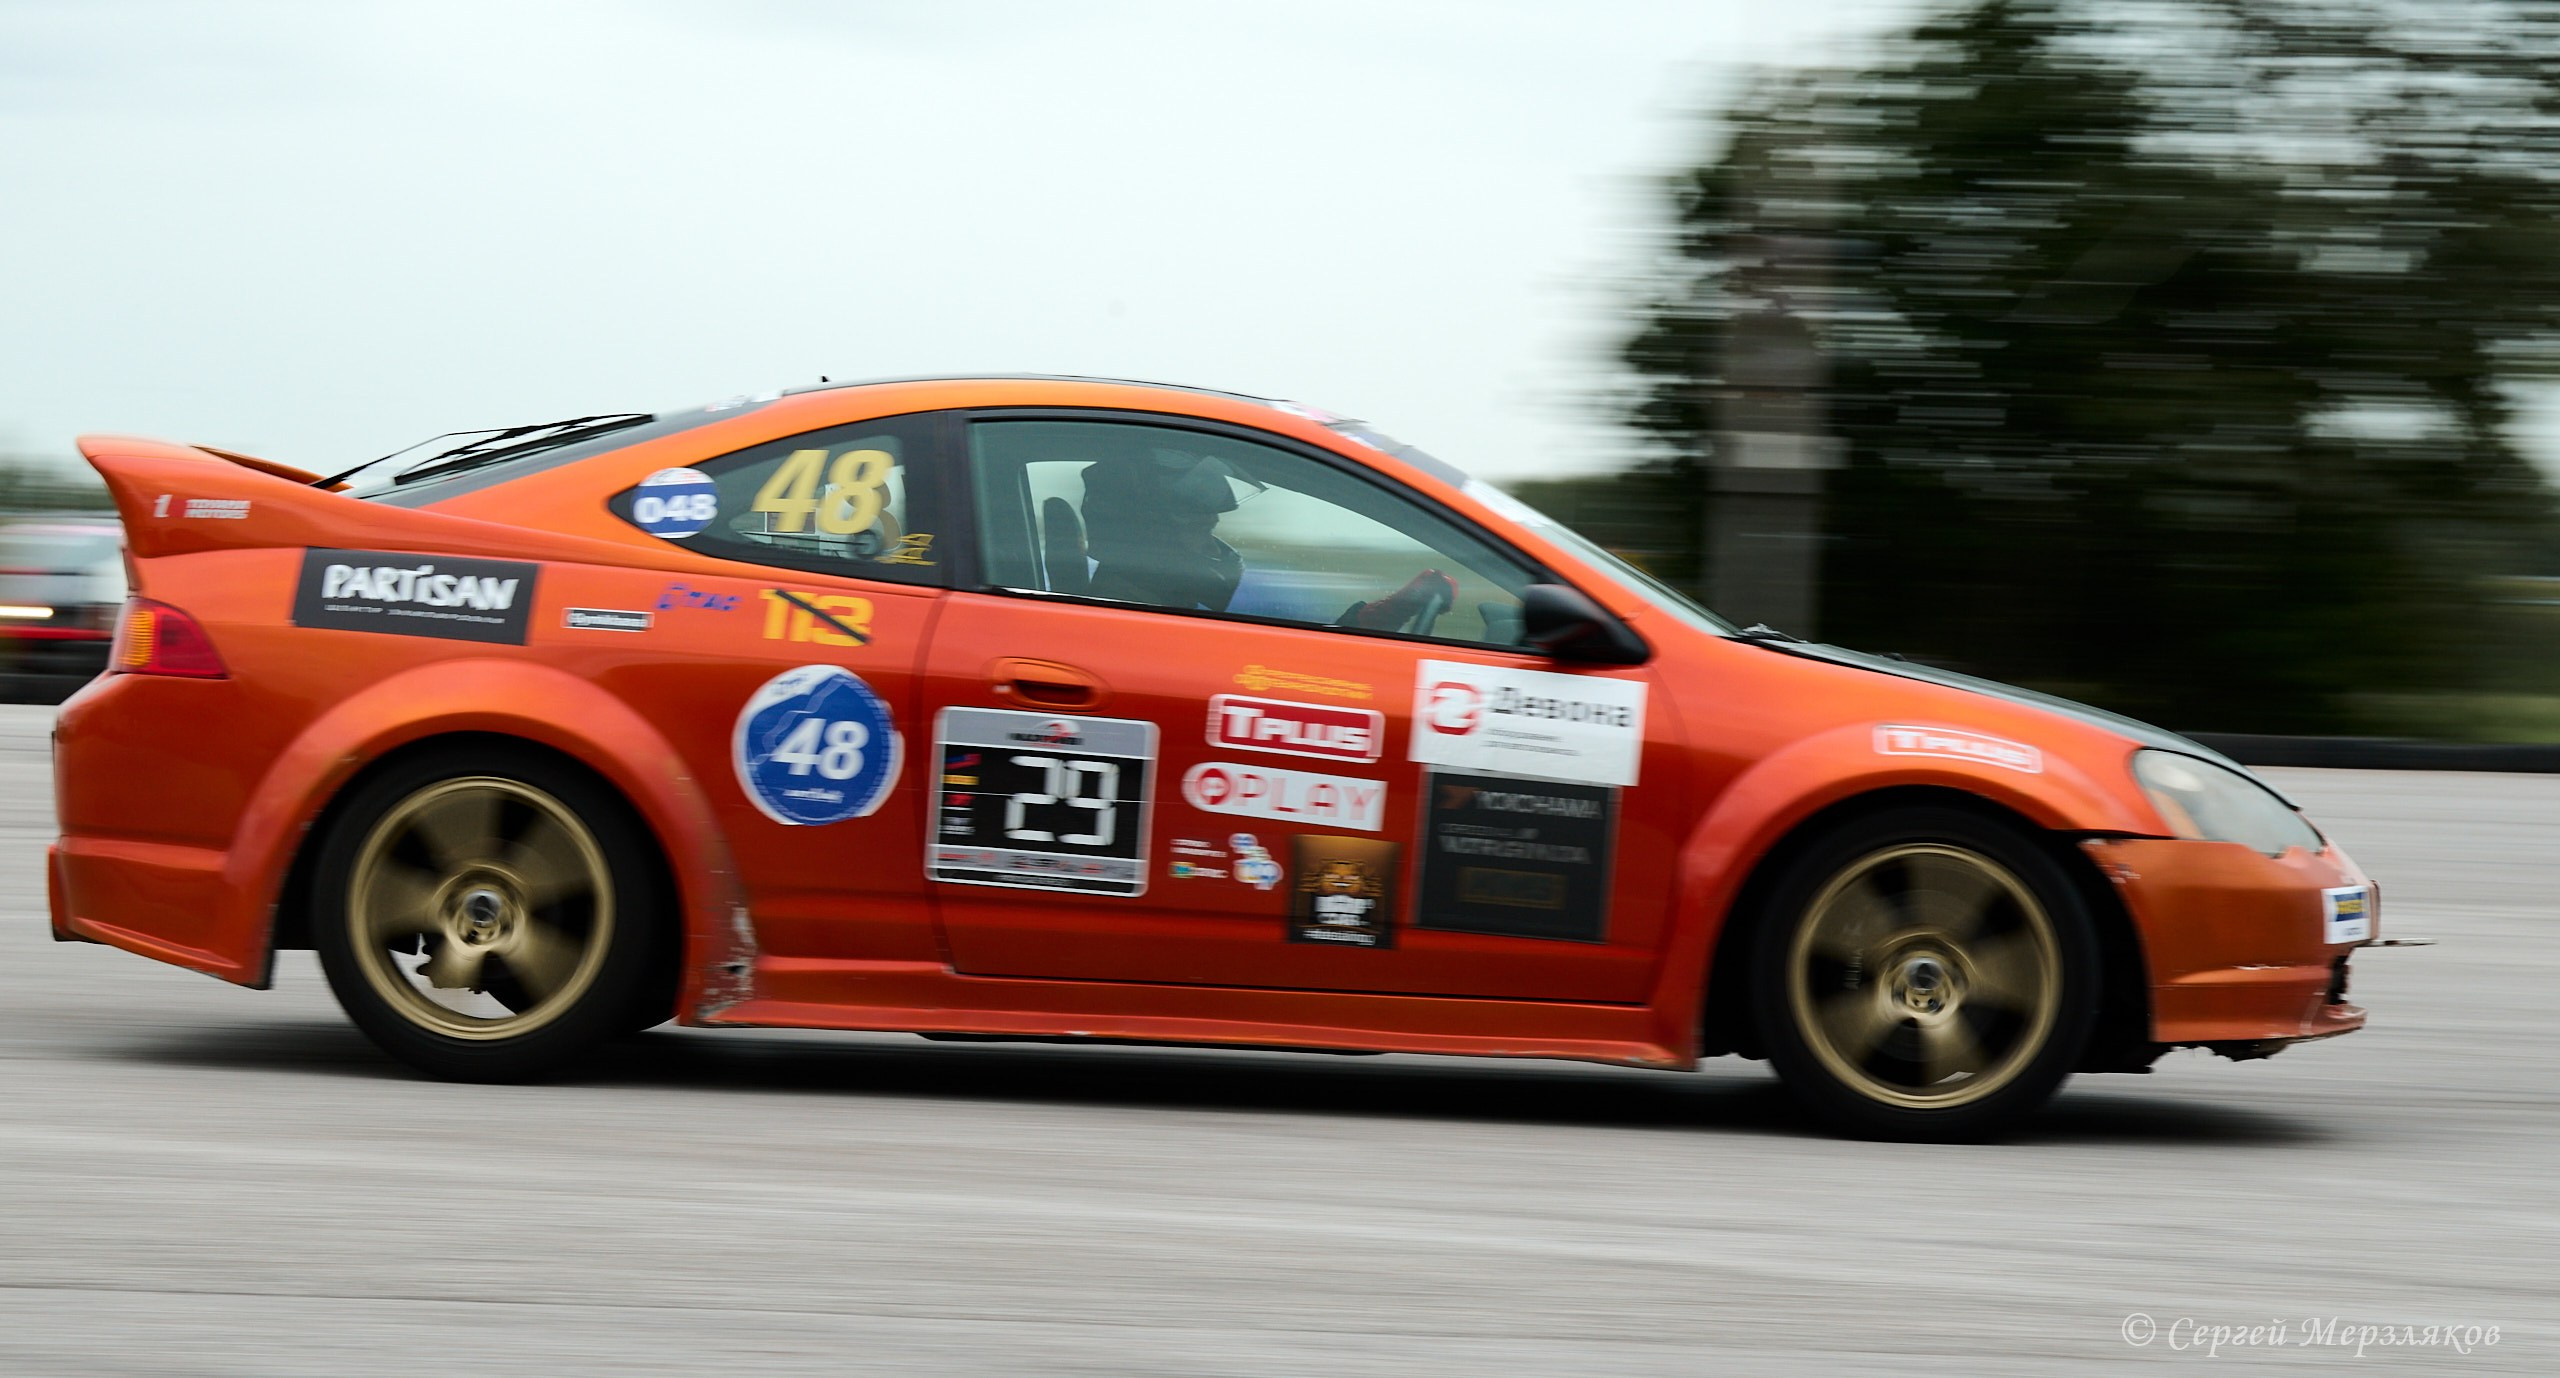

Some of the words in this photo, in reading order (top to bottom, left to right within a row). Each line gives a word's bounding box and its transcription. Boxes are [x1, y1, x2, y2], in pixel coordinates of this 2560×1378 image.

[633, 493, 718, 524] 048
[752, 449, 894, 534] 48
[1486, 685, 1639, 728] Девона
[770, 717, 870, 780] 48
[1003, 755, 1120, 846] 29
